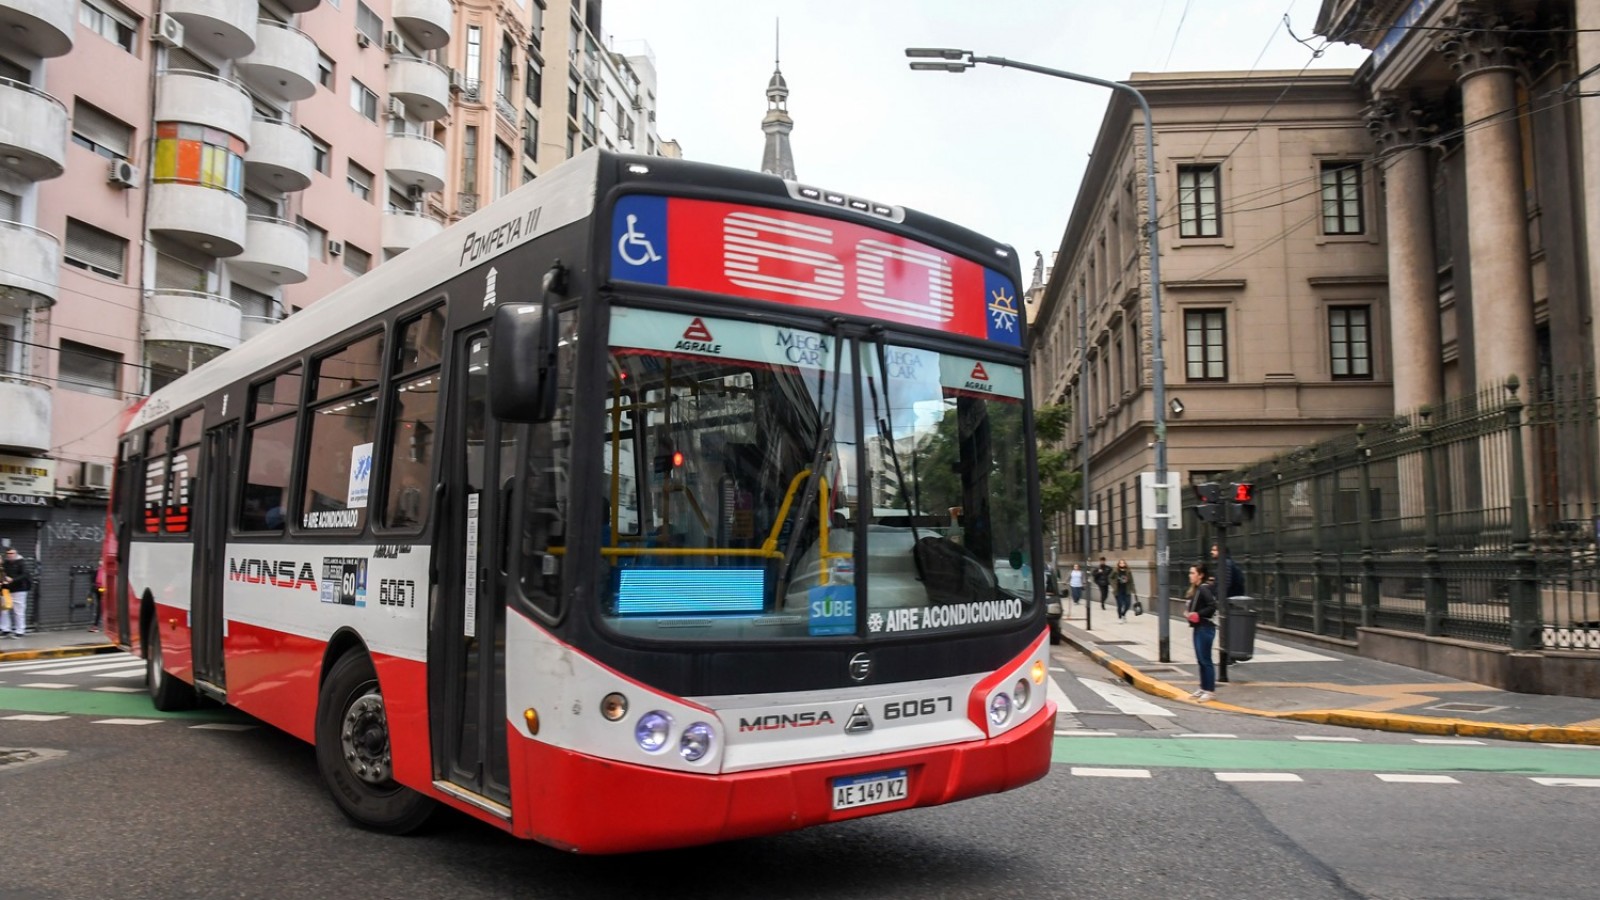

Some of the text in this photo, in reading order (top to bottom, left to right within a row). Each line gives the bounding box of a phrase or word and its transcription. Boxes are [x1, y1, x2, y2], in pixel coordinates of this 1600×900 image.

[460, 206, 542, 267] POMPEYA III
[723, 212, 954, 323] 60
[674, 340, 722, 354] AGRALE
[776, 330, 829, 353] MEGA
[785, 345, 823, 366] CAR
[886, 362, 917, 380] CAR
[964, 381, 993, 392] AGRALE
[230, 558, 317, 591] MONSA
[342, 572, 356, 596] 60
[380, 578, 415, 608] 6067
[812, 600, 853, 618] SUBE
[885, 598, 1022, 632] AIRE ACONDICIONADO
[884, 696, 953, 720] 6067
[739, 711, 835, 732] MONSA
[837, 787, 854, 806] AE
[858, 782, 883, 803] 149
[887, 779, 904, 798] KZ
